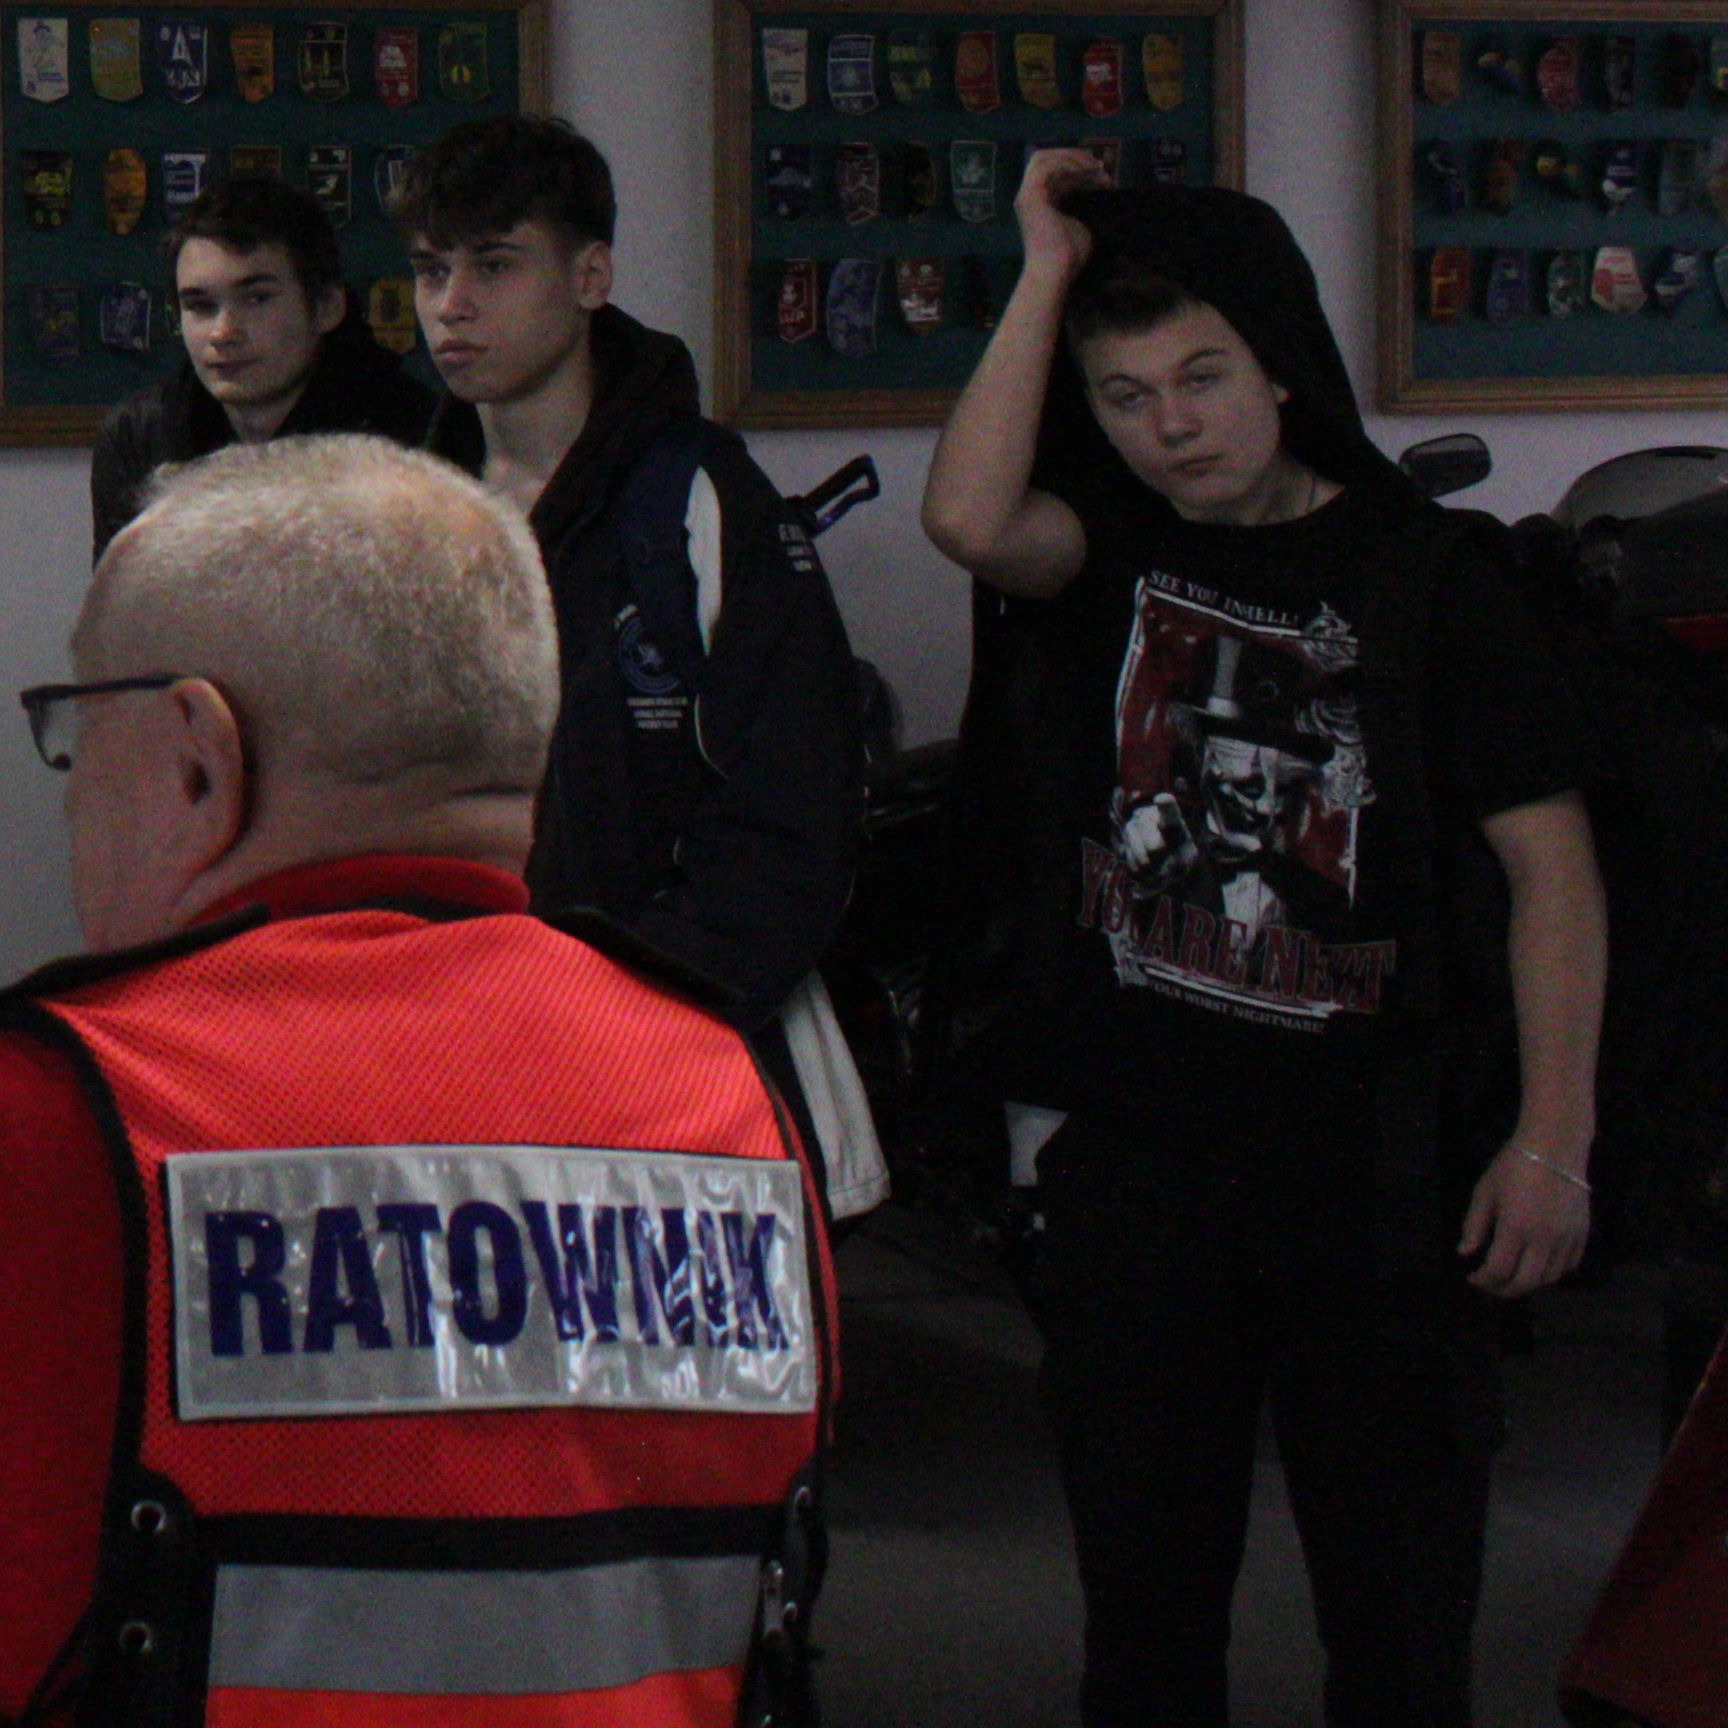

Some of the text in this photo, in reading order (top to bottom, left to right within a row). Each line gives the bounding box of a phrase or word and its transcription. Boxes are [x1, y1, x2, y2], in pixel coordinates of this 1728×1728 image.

[1148, 569, 1181, 593] SEE
[1185, 580, 1219, 606] YOU
[1142, 895, 1249, 990] ARE
[205, 1201, 790, 1355] RATOWNIK
